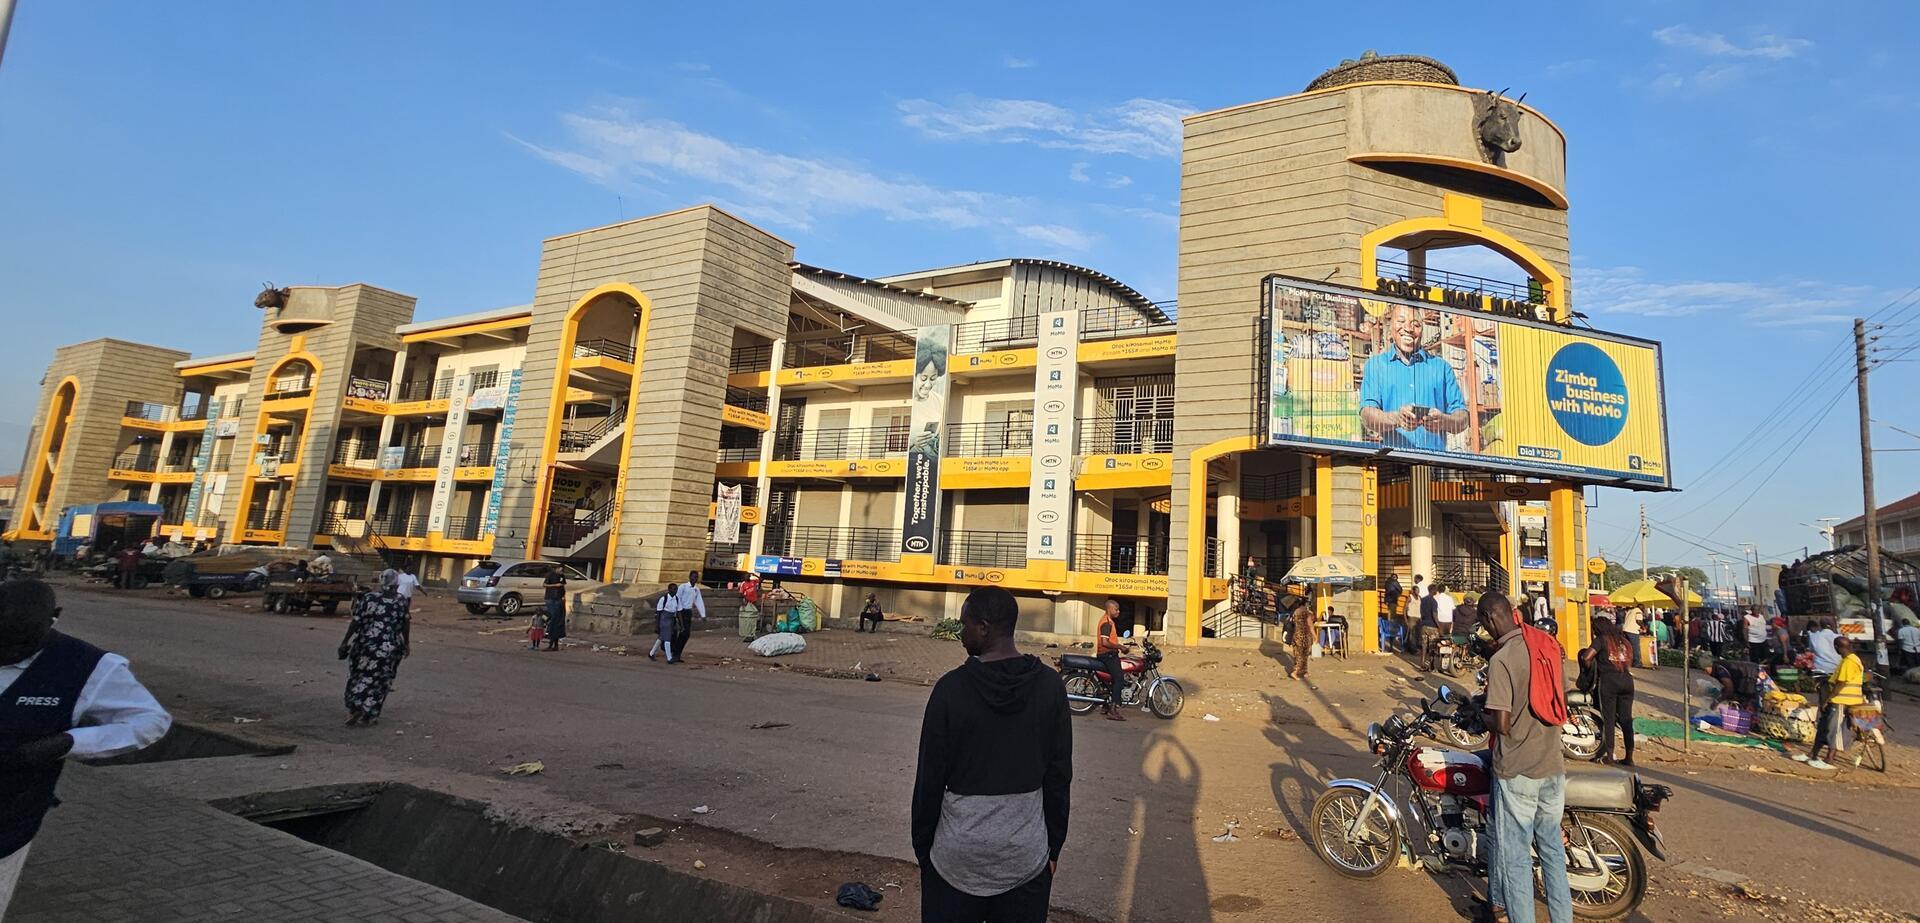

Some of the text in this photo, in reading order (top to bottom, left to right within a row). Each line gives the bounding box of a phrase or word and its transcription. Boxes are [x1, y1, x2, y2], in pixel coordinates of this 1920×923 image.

[1289, 287, 1358, 305] MoMo For Business
[1443, 288, 1483, 310] MAIN
[1555, 369, 1598, 388] Zimba
[1566, 384, 1625, 405] business
[1551, 398, 1622, 419] with MoMo
[1520, 447, 1535, 456] Dial
[1643, 460, 1661, 468] MoMo
[615, 470, 626, 512] GATE
[920, 459, 930, 520] unstoppable.
[911, 479, 922, 526] Together,
[612, 516, 618, 536] 02
[16, 696, 60, 706] PRESS
